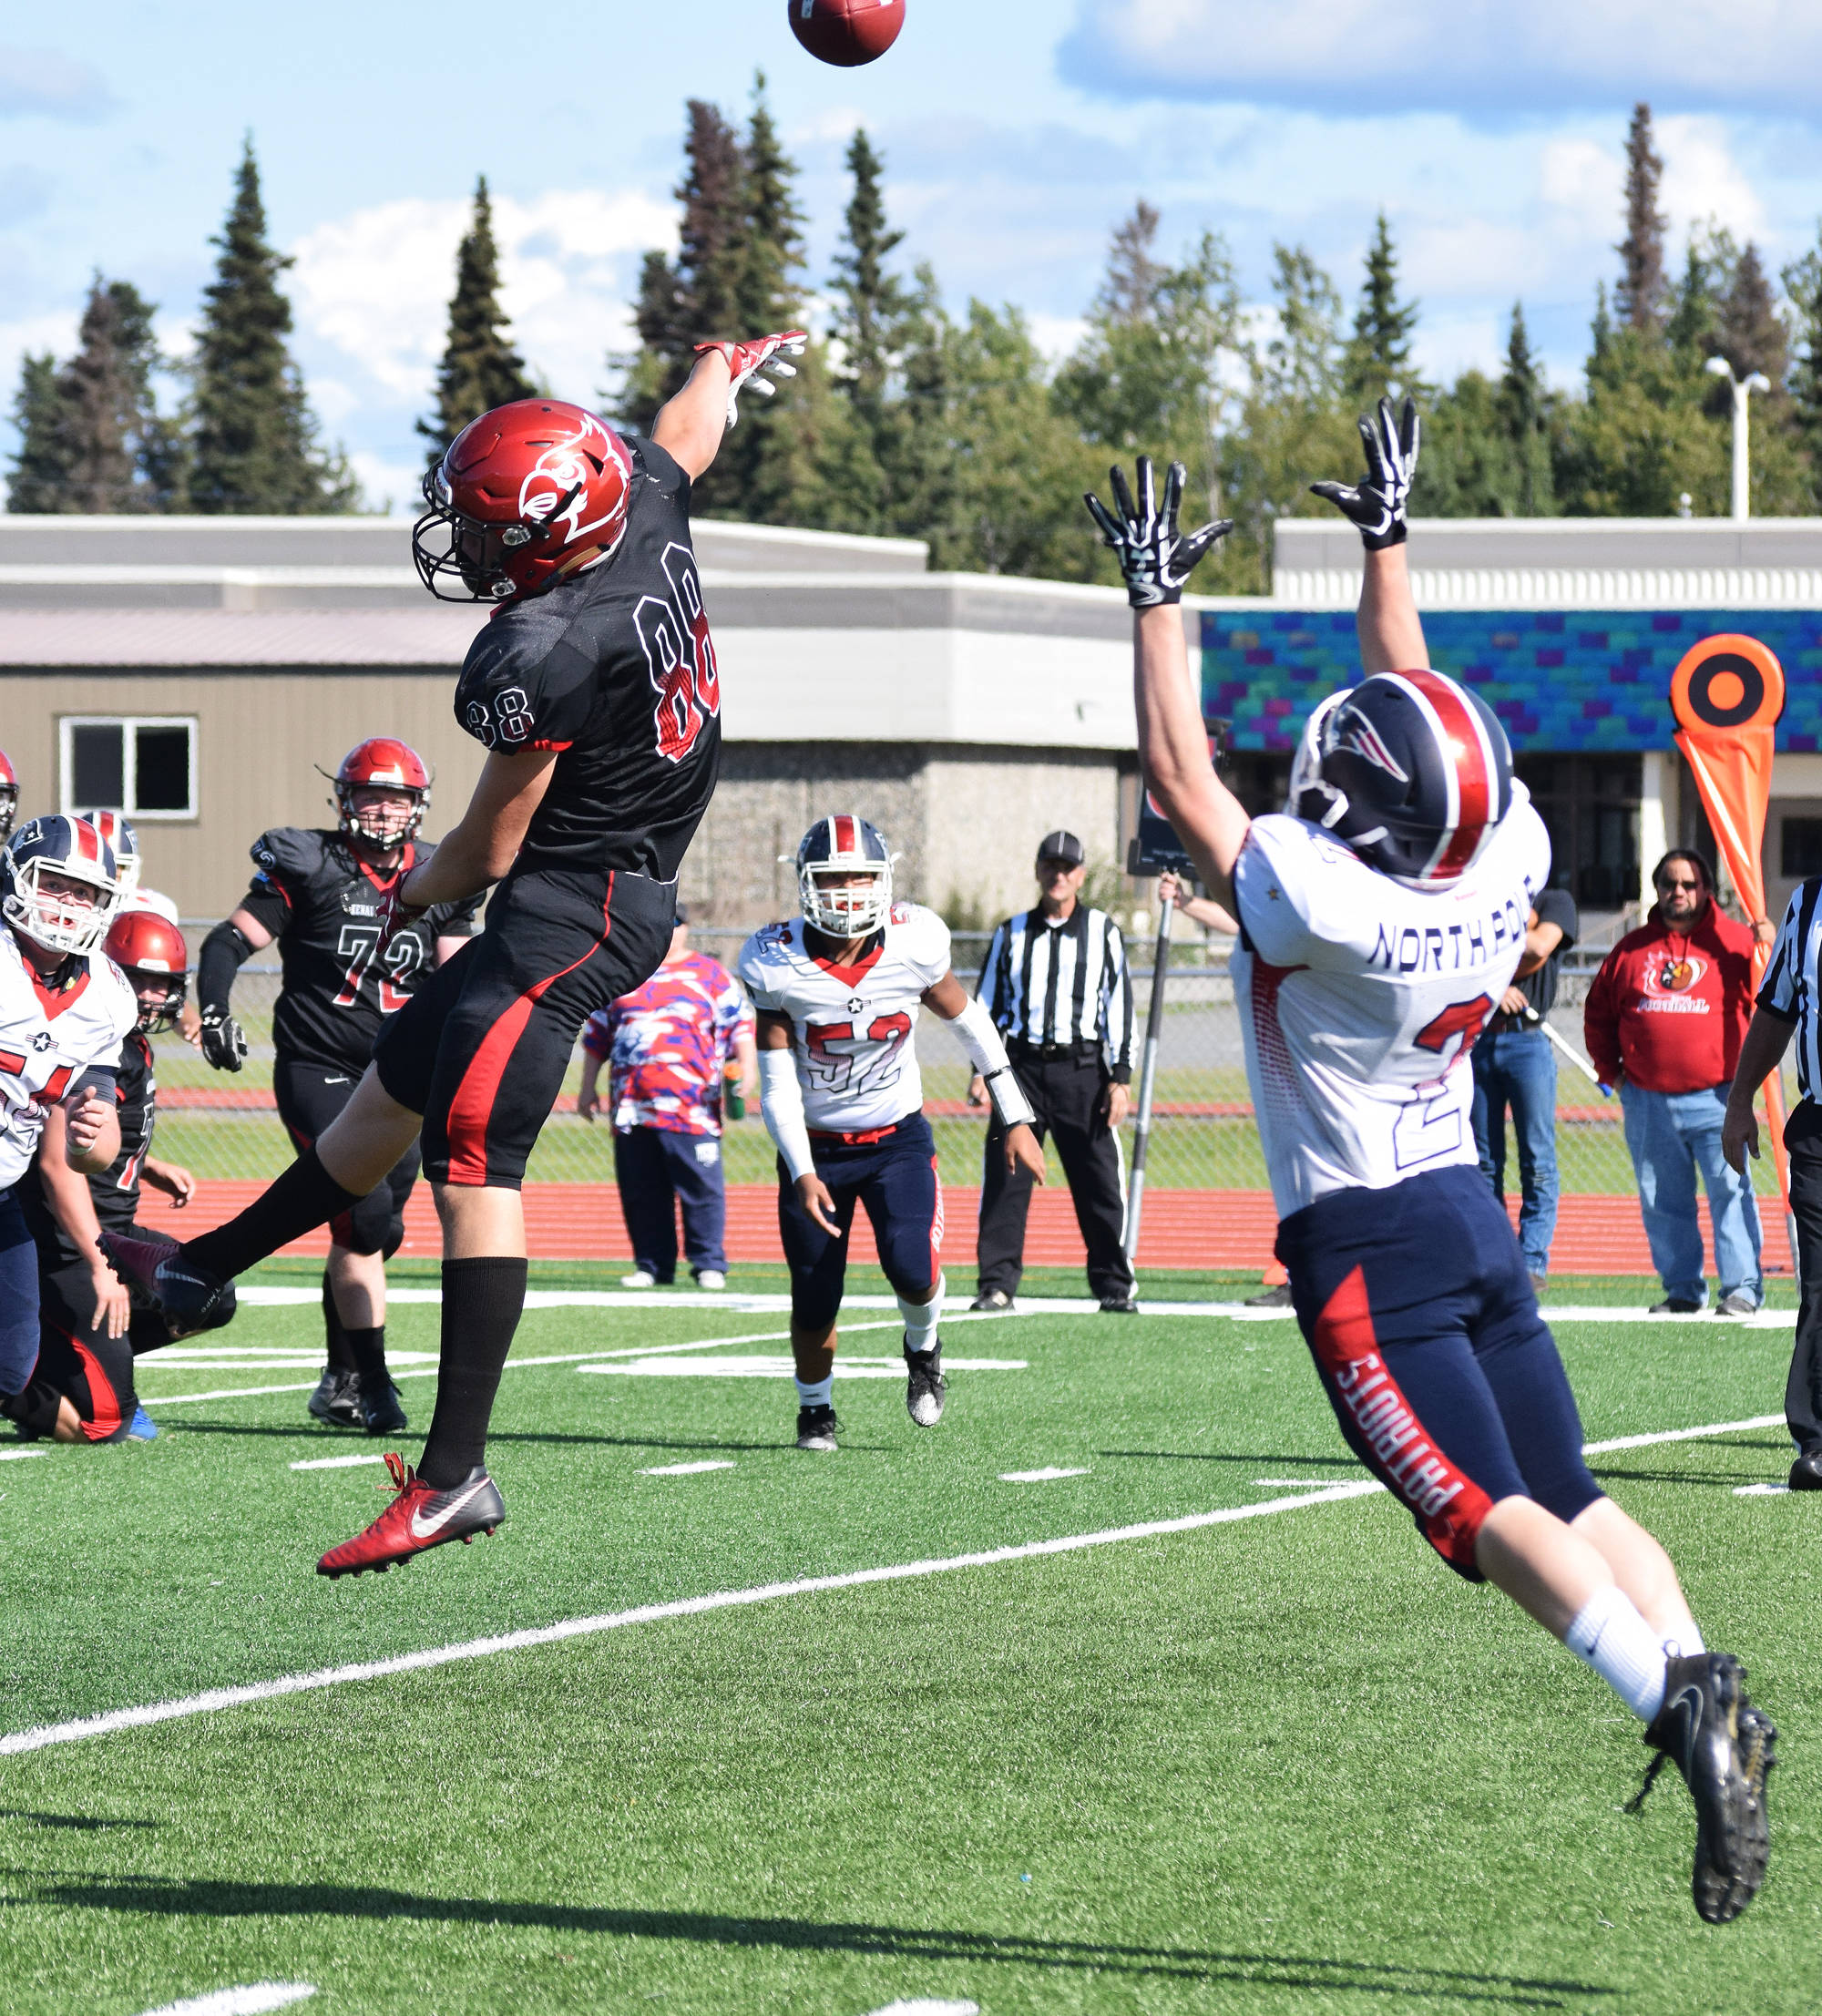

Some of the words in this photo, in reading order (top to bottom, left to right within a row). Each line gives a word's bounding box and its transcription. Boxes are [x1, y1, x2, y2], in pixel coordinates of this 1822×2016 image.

[632, 541, 721, 763] 88
[466, 687, 535, 749] 88
[333, 924, 424, 1013] 72
[1367, 922, 1487, 973] NORTH
[805, 1010, 912, 1095] 52
[1393, 991, 1493, 1172] 2
[1336, 1353, 1465, 1518] PATRIOTS
